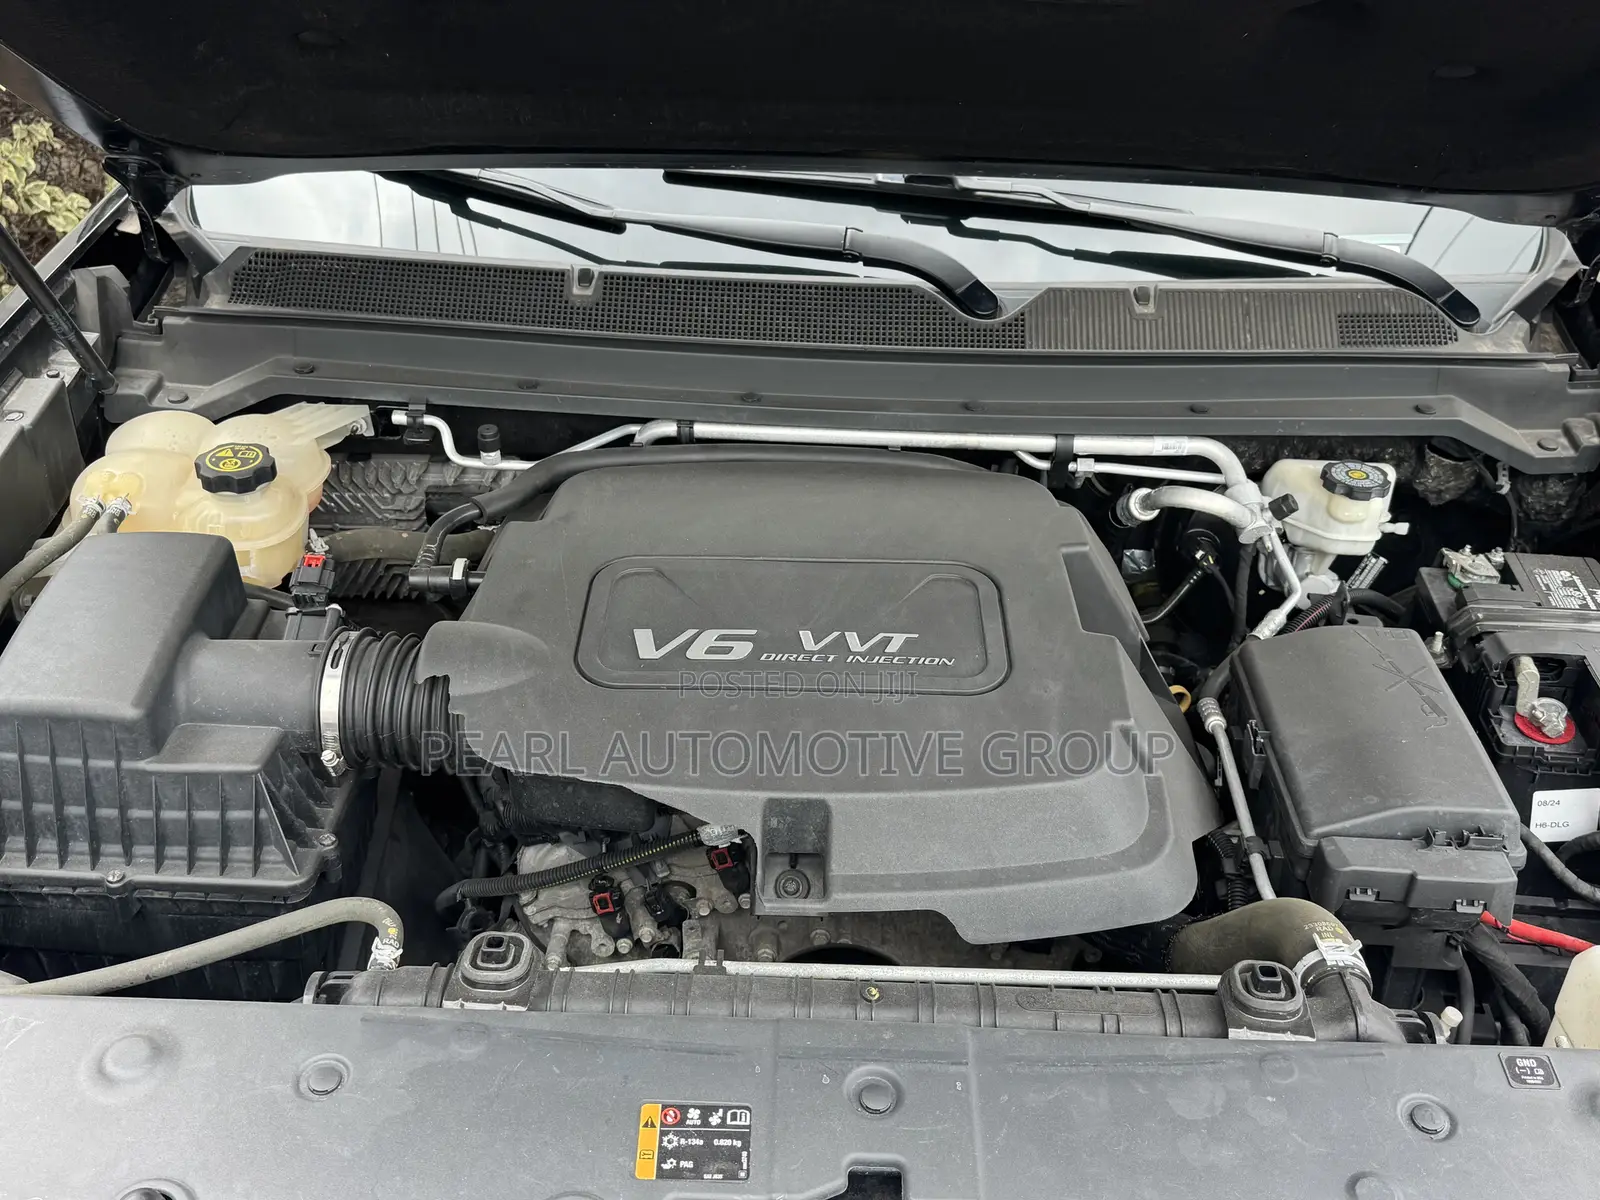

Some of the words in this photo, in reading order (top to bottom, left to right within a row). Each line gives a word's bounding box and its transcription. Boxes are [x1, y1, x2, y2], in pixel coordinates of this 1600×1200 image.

[633, 629, 758, 661] V6
[799, 630, 919, 653] VVT
[760, 652, 839, 663] DIRECT
[845, 655, 956, 666] INJECTION
[383, 938, 399, 948] RAD
[1516, 1058, 1537, 1067] GND
